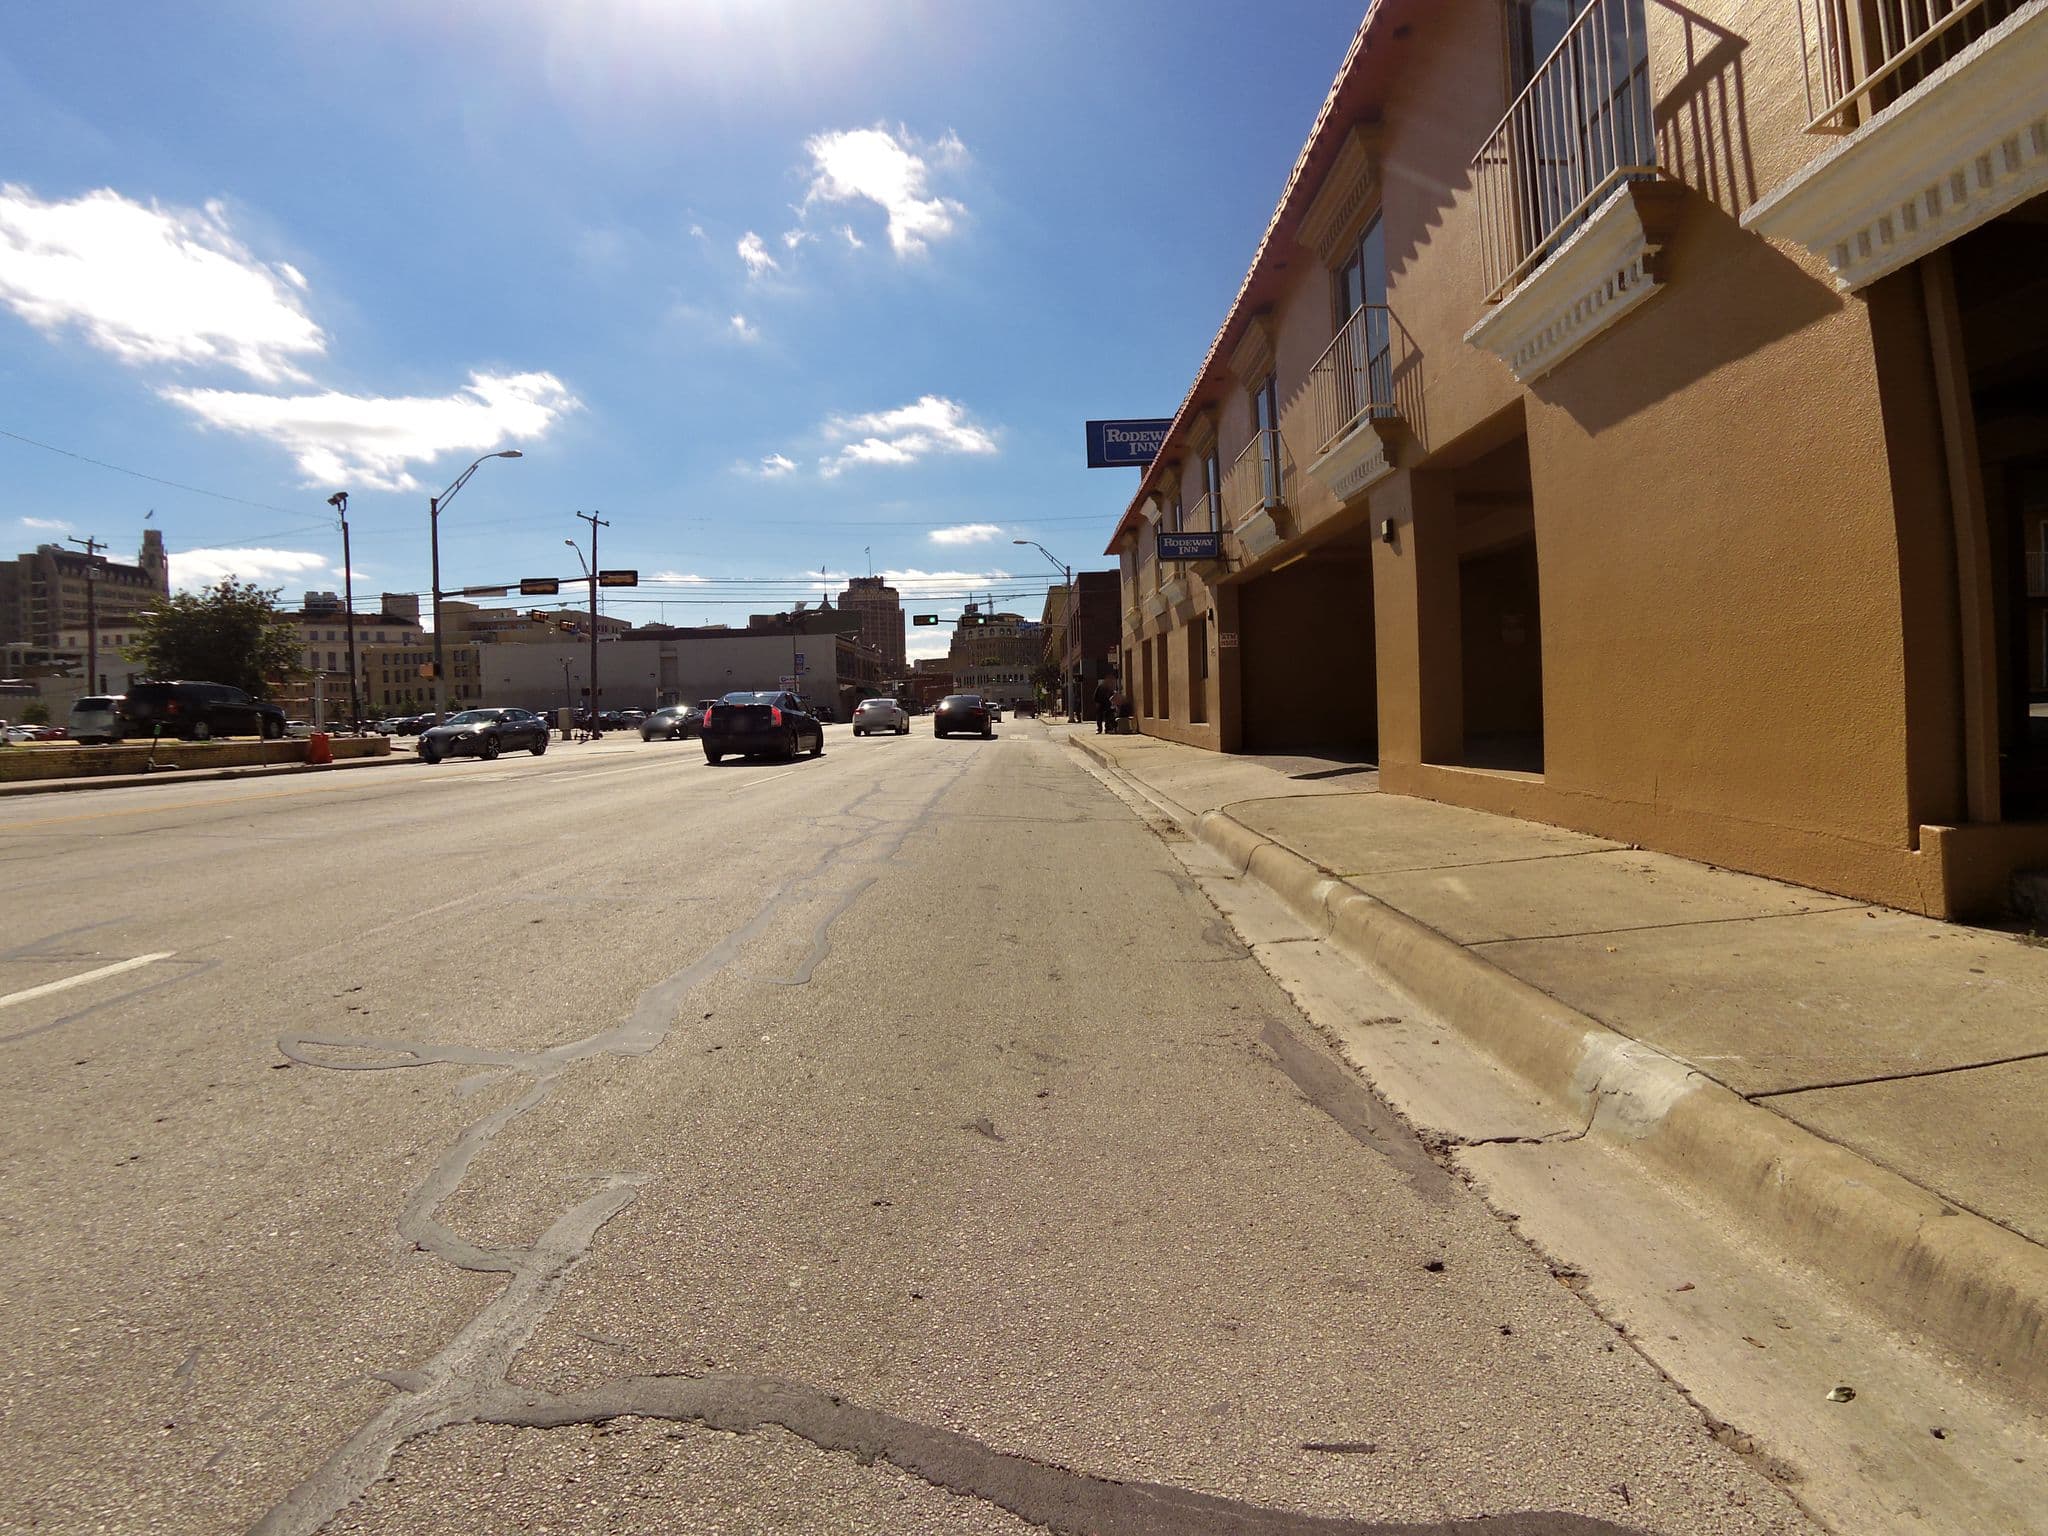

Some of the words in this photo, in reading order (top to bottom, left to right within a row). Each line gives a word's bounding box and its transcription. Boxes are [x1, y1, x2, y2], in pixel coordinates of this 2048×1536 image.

[1106, 429, 1166, 442] RODEW
[1129, 442, 1159, 455] INN
[1163, 538, 1213, 547] RODEWAY
[1178, 546, 1199, 554] INN
